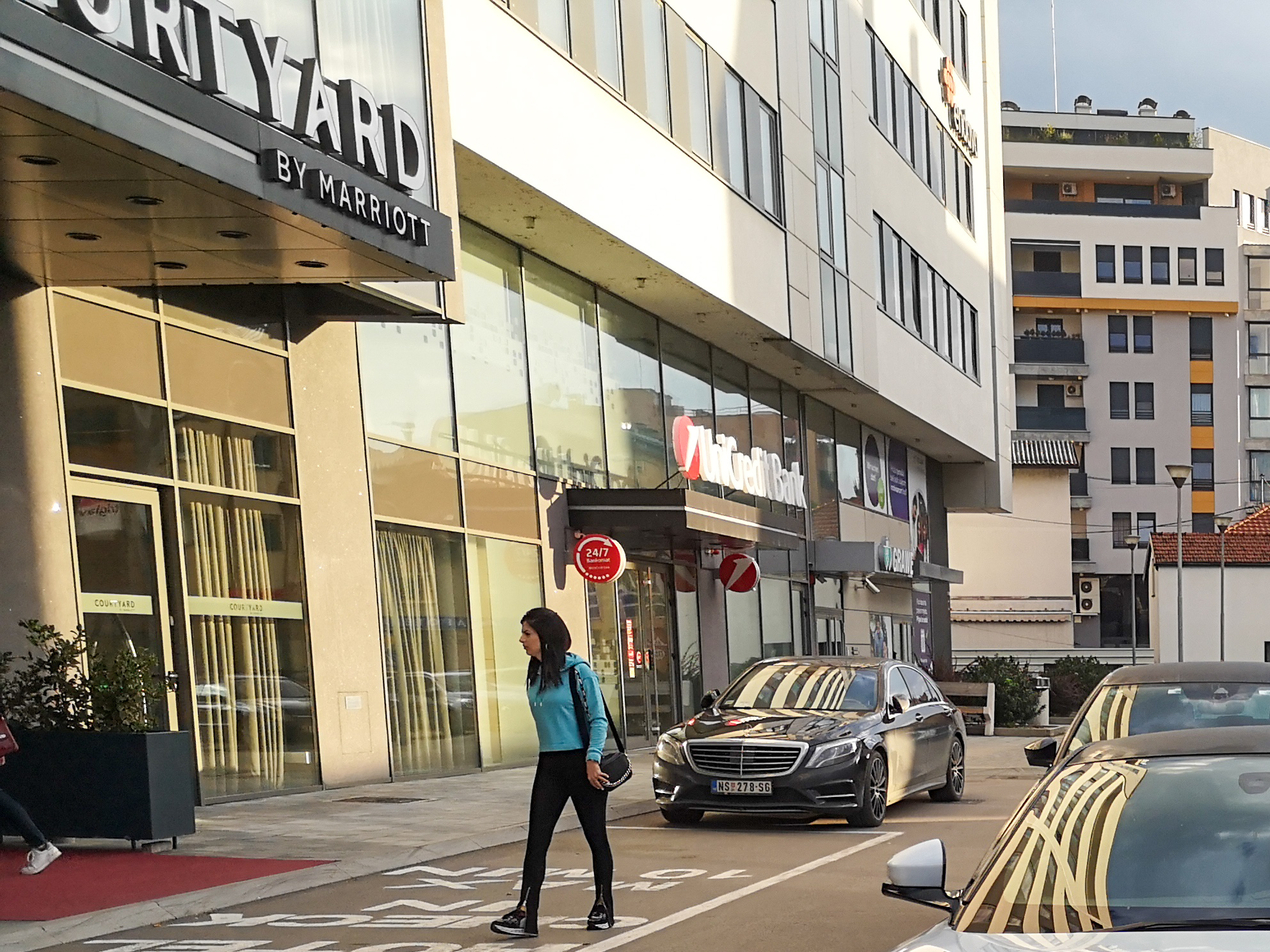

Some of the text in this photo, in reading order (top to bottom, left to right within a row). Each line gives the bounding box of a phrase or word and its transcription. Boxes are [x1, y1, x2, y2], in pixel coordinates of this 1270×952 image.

[276, 149, 431, 247] BY MARRIOTT
[696, 425, 808, 509] UniCredit Bank
[585, 547, 609, 558] 24/7
[718, 782, 730, 791] NS
